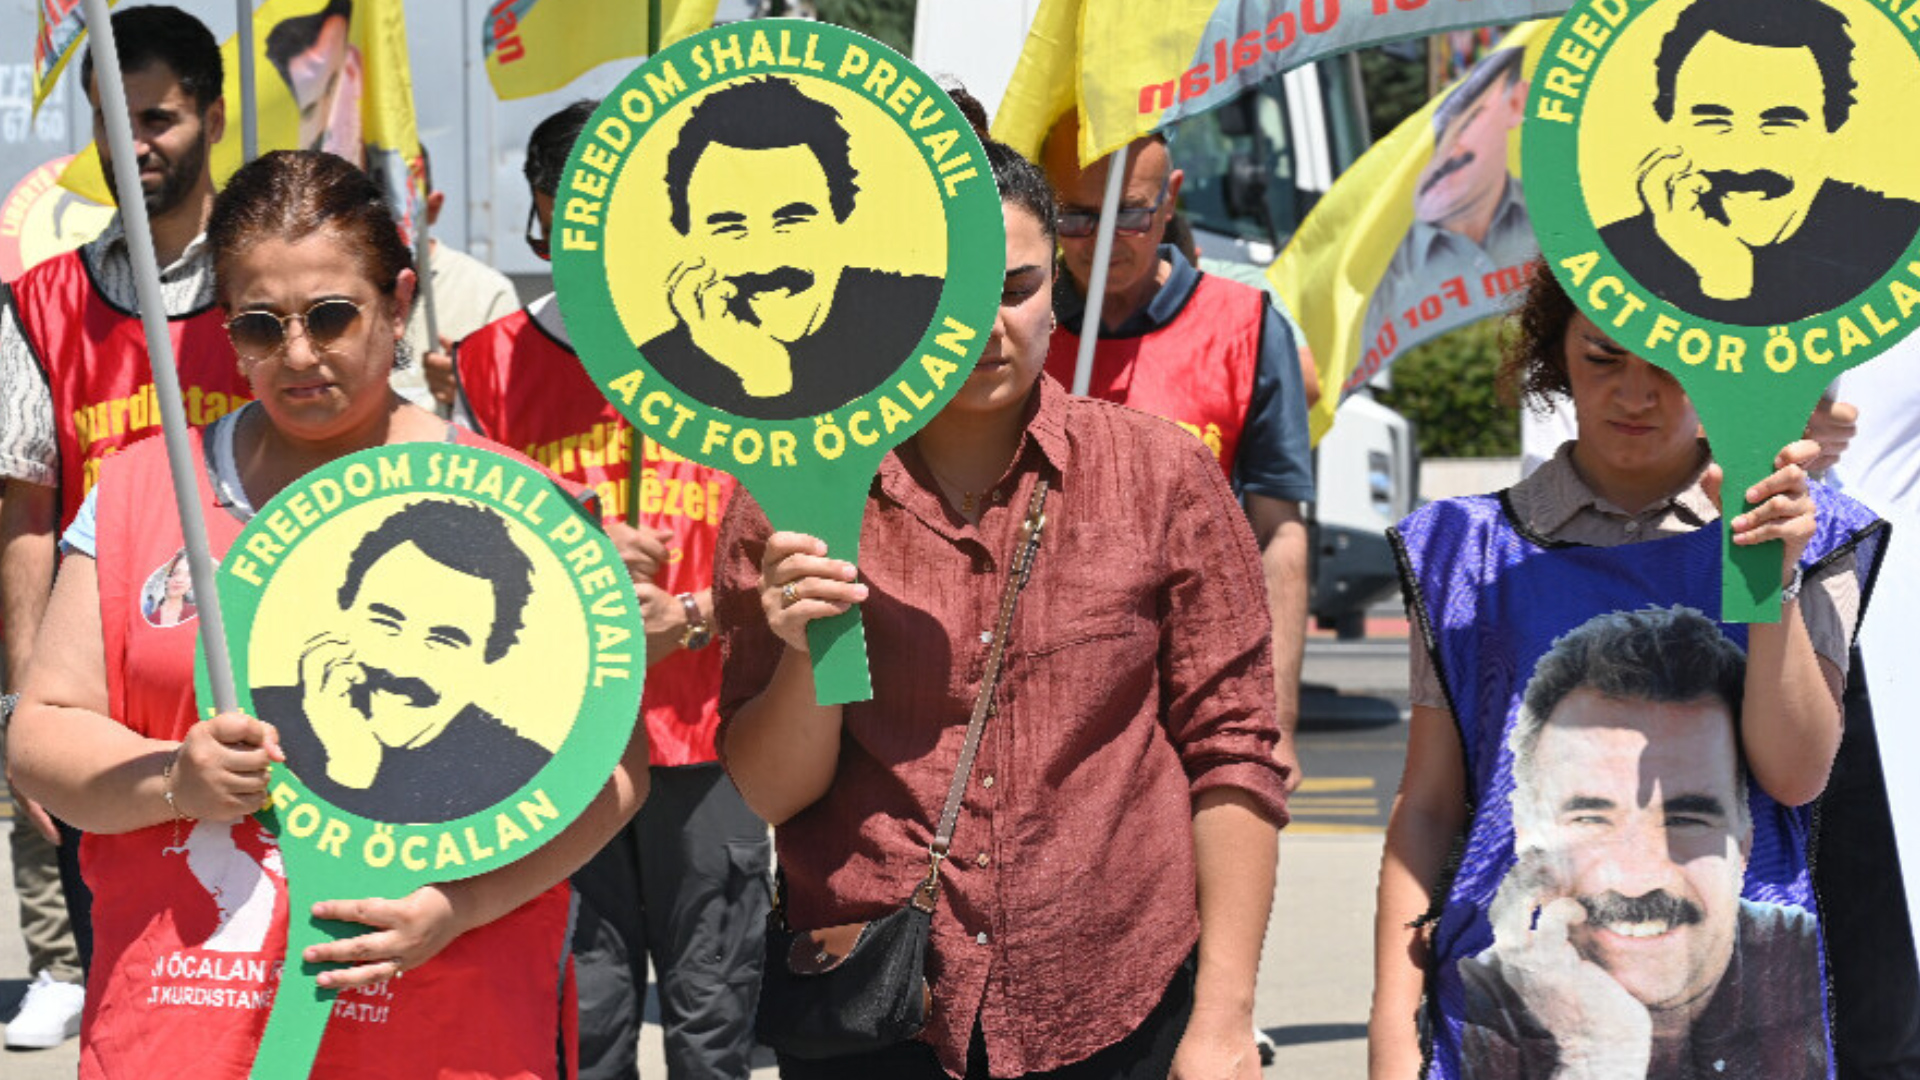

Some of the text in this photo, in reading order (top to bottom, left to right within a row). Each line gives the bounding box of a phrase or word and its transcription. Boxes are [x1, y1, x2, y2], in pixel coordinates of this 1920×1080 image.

[1537, 0, 1630, 124] FREED
[563, 60, 687, 252] FREEDOM
[691, 30, 825, 82] SHALL
[837, 44, 979, 198] PREVAIL
[1560, 251, 1647, 328] ACT
[1645, 314, 1747, 374] FOR
[608, 316, 977, 467] ACT FOR ÖCALAN
[230, 452, 412, 586] FREEDOM
[426, 452, 550, 526] SHALL
[548, 514, 633, 687] PREVAIL
[262, 781, 560, 871] FOR ÖCALAN
[166, 951, 266, 983] ÖCALAN
